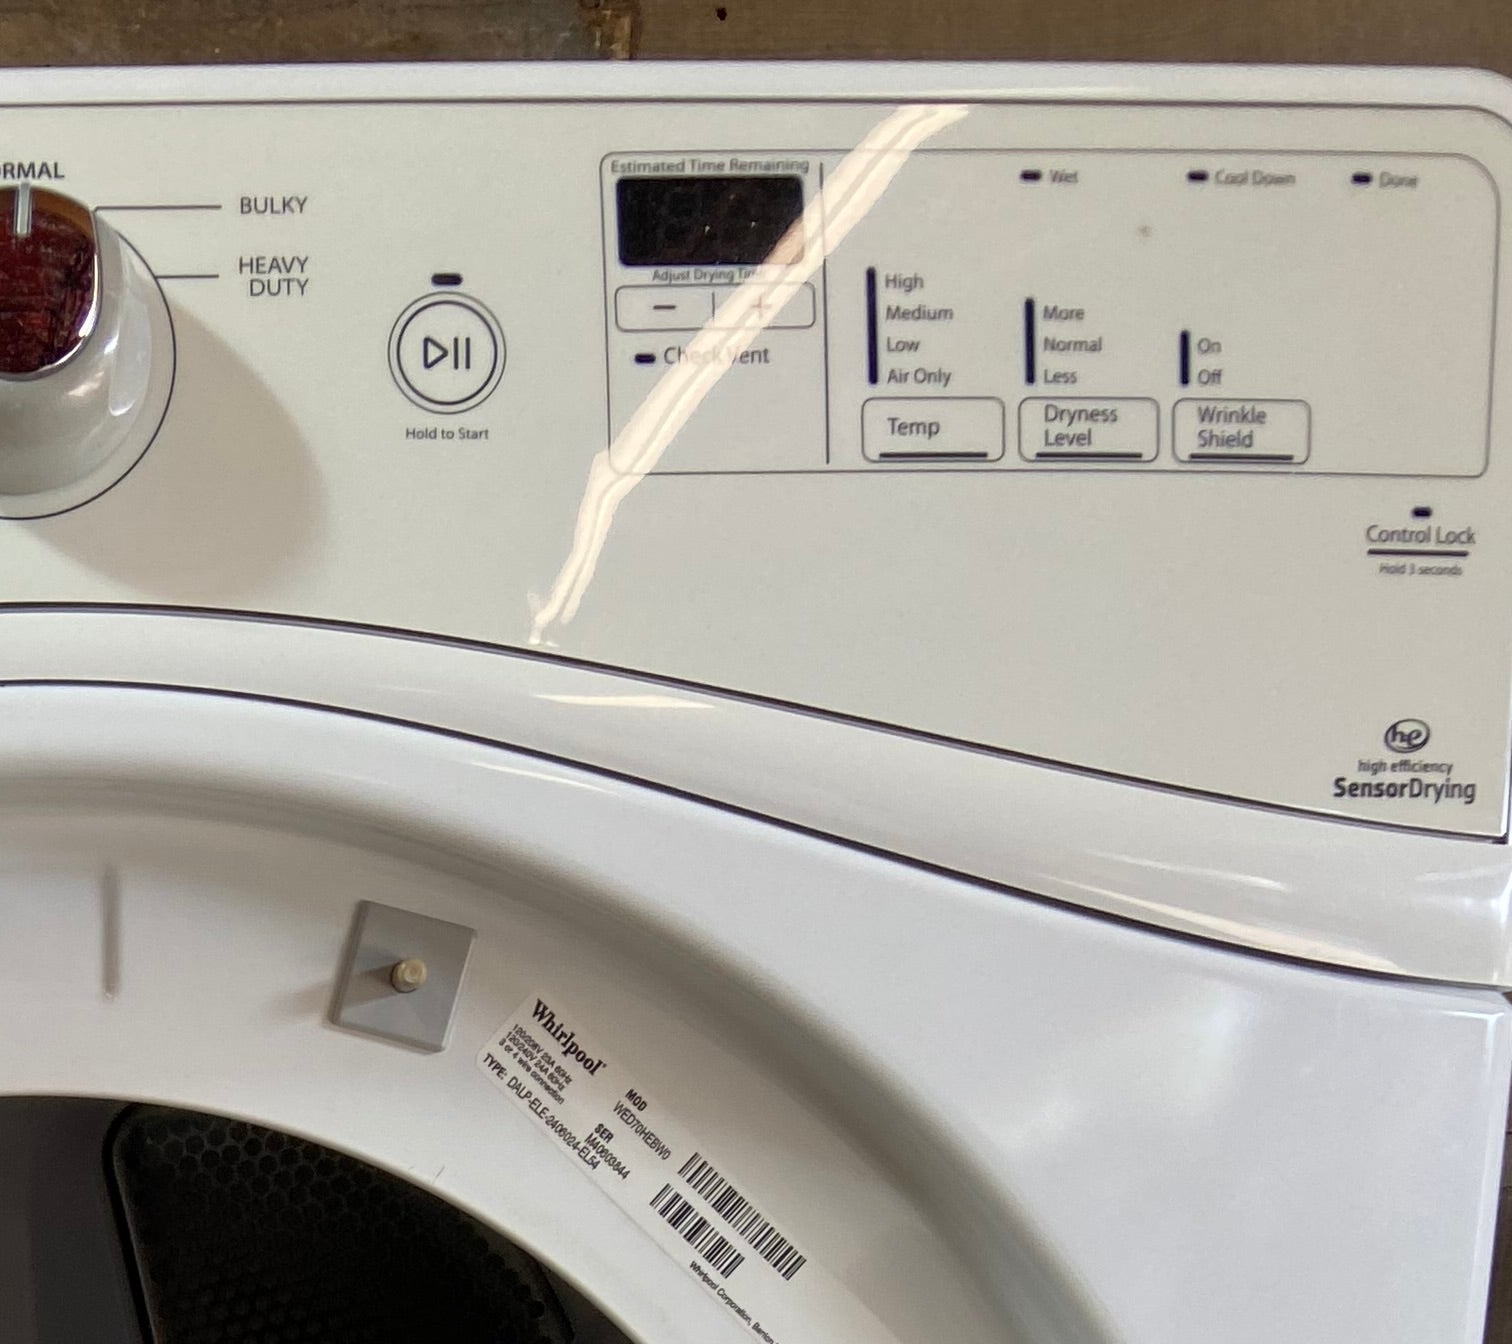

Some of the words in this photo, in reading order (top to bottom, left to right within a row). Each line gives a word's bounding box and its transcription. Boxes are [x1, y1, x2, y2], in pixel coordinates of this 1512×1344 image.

[611, 159, 686, 174] Estimated
[690, 159, 724, 173] Time
[729, 159, 810, 176] Remaining
[1049, 169, 1078, 184] Wet
[240, 196, 308, 214] BULKY
[239, 256, 309, 275] HEAVY
[652, 269, 690, 283] Adjust
[694, 269, 734, 282] Drying
[885, 273, 924, 293] High
[250, 278, 309, 297] DUTY
[886, 305, 954, 321] Medium
[1043, 305, 1085, 321] More
[886, 336, 921, 353] Low
[1043, 336, 1103, 352] Normal
[1197, 337, 1222, 354] On
[888, 368, 910, 384] Air
[913, 368, 952, 388] Only
[1043, 369, 1078, 384] Less
[1197, 368, 1223, 385] Off
[1044, 404, 1118, 426] Dryness
[1197, 405, 1267, 425] Wrinkle
[405, 427, 437, 440] Hold
[440, 428, 454, 440] to
[458, 427, 489, 440] Start
[887, 418, 940, 439] Temp
[1044, 428, 1092, 447] Level
[1197, 429, 1255, 448] Shield
[1365, 525, 1431, 544] Control
[1435, 526, 1476, 545] Lock
[1418, 564, 1463, 577] seconds
[1357, 759, 1386, 776] high
[1390, 759, 1453, 776] efficiency
[1333, 776, 1476, 804] SensorDrying
[532, 998, 602, 1076] Whirlpool
[625, 1089, 648, 1112] MOD
[594, 1123, 614, 1144] SER
